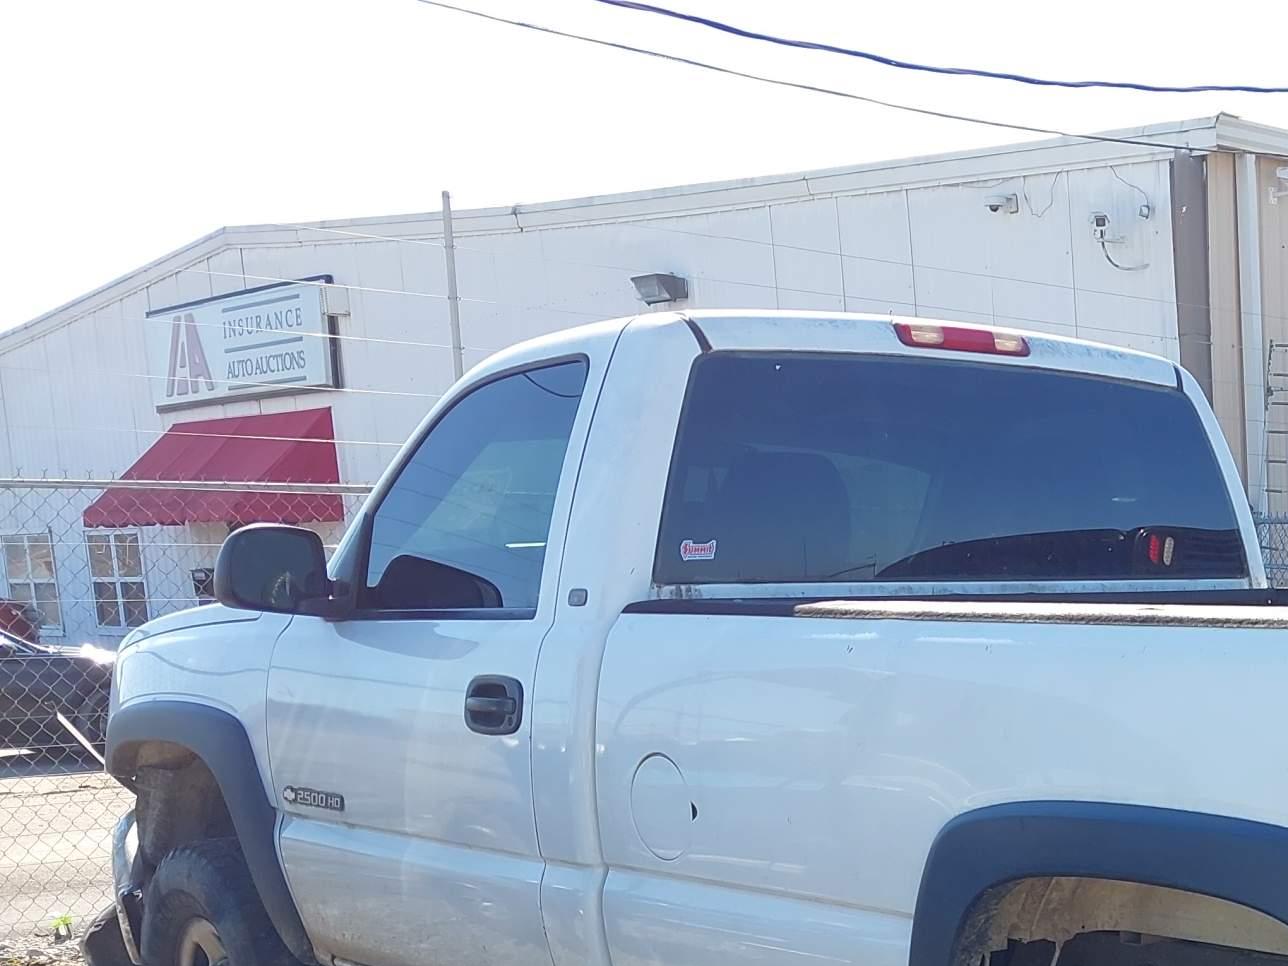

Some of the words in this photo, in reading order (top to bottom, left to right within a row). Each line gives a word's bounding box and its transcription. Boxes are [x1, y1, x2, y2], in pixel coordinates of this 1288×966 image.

[223, 308, 303, 339] INSURANCE
[227, 359, 254, 379] AUTO
[255, 350, 306, 376] AUCTIONS
[297, 790, 326, 807] 2500
[327, 796, 341, 808] HD
